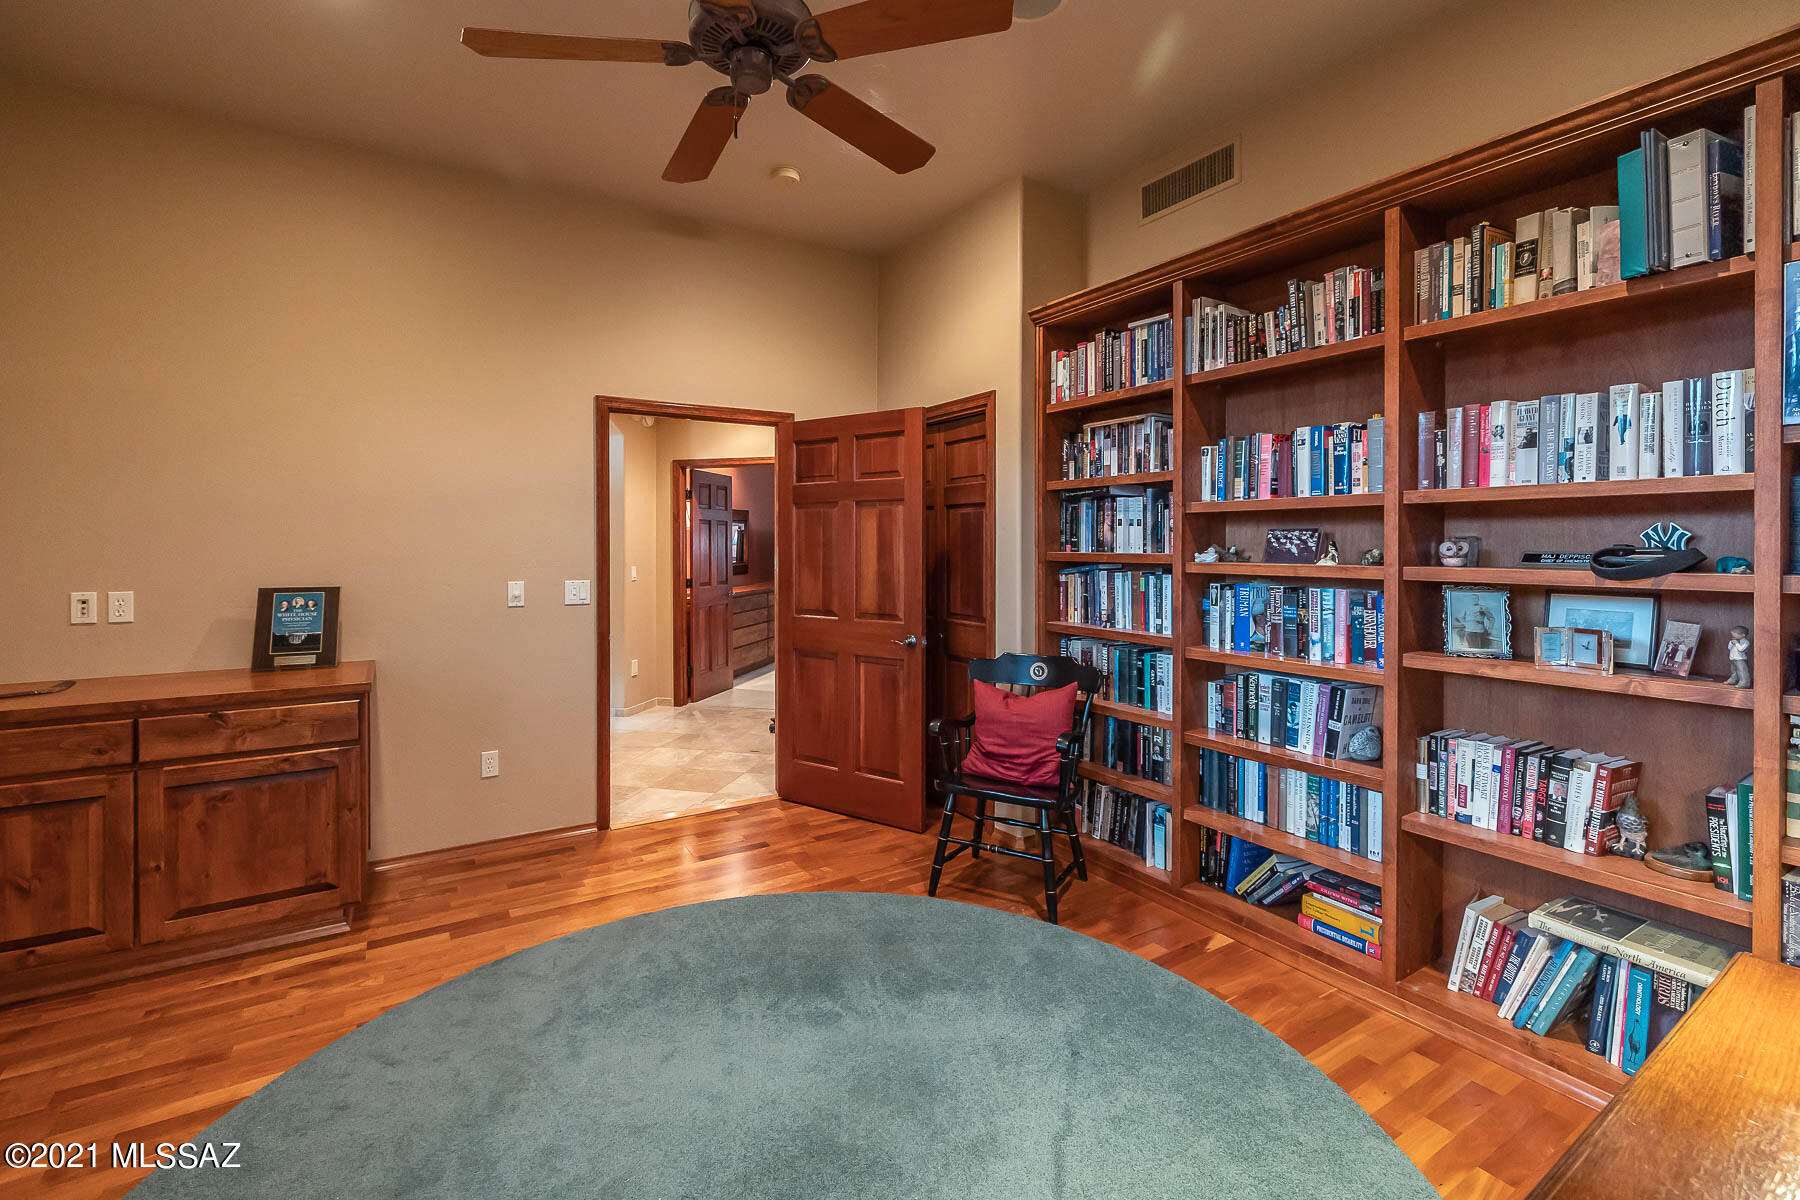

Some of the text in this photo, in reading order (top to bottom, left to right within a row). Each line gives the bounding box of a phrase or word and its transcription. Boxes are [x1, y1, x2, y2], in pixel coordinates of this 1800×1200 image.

[1715, 376, 1735, 427] Dutch
[1546, 428, 1555, 481] THE FINAL DAYS
[1239, 587, 1249, 617] TRUMAN
[1249, 675, 1258, 709] Kennedys
[1307, 684, 1315, 716] PRESIDENT
[1343, 712, 1372, 726] CAMELOT
[1480, 771, 1488, 800] STEWART
[1524, 765, 1536, 822] CLINTON SYNDROME
[1537, 779, 1547, 806] TARGET
[1575, 773, 1583, 798] BUSHES
[1597, 780, 1606, 790] THE
[1588, 817, 1600, 843] PRESIDENT
[1708, 816, 1721, 857] PRESIDENTS
[1719, 824, 1728, 846] Haunting
[1342, 936, 1363, 949] DISABILITY
[1489, 927, 1498, 944] AMERICA
[1538, 919, 1552, 932] The
[1600, 943, 1609, 952] of
[1615, 947, 1643, 963] North
[1646, 955, 1687, 979] America
[1634, 982, 1643, 1014] ORNITHOLOGY
[1657, 975, 1671, 1006] BIRDS
